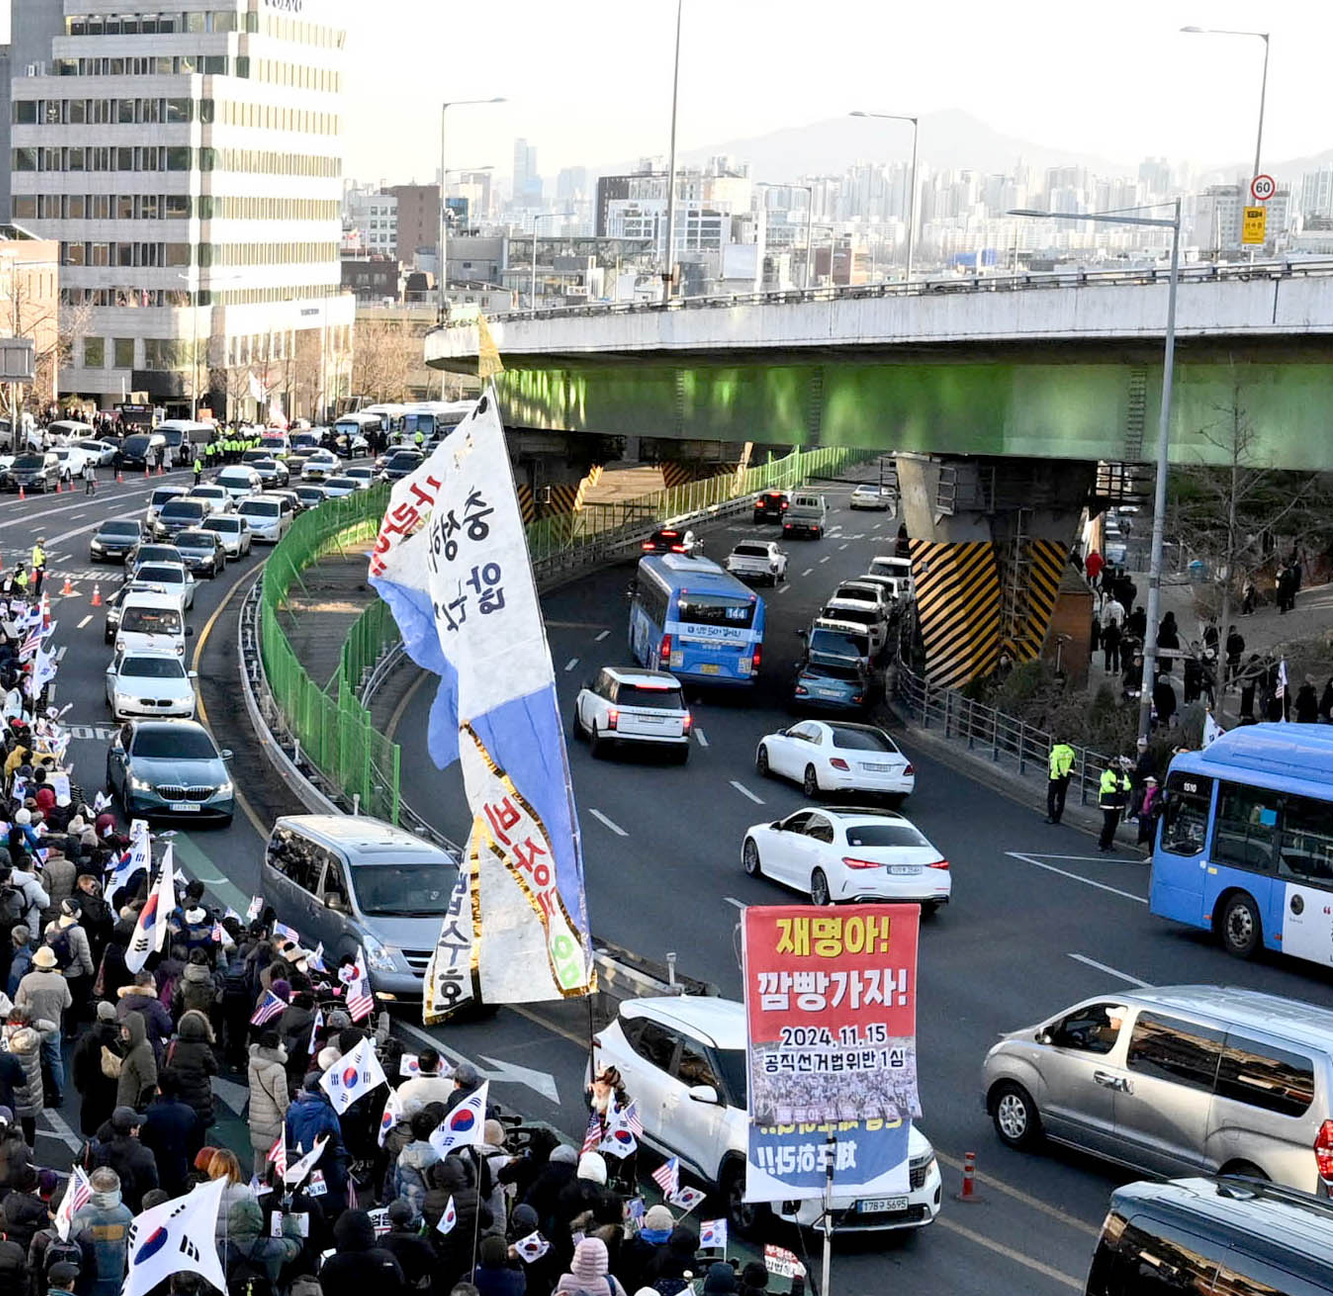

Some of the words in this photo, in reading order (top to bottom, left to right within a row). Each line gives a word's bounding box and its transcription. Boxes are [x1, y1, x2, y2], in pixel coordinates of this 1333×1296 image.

[1255, 182, 1271, 193] 60
[728, 608, 745, 619] 144
[1184, 782, 1197, 793] 1510
[776, 916, 890, 957] 재명아!
[758, 969, 909, 1012] 깜빵가자!
[764, 1053, 876, 1073] 공직선거법위반
[881, 1050, 905, 1068] 1심
[886, 1199, 907, 1210] 5695
